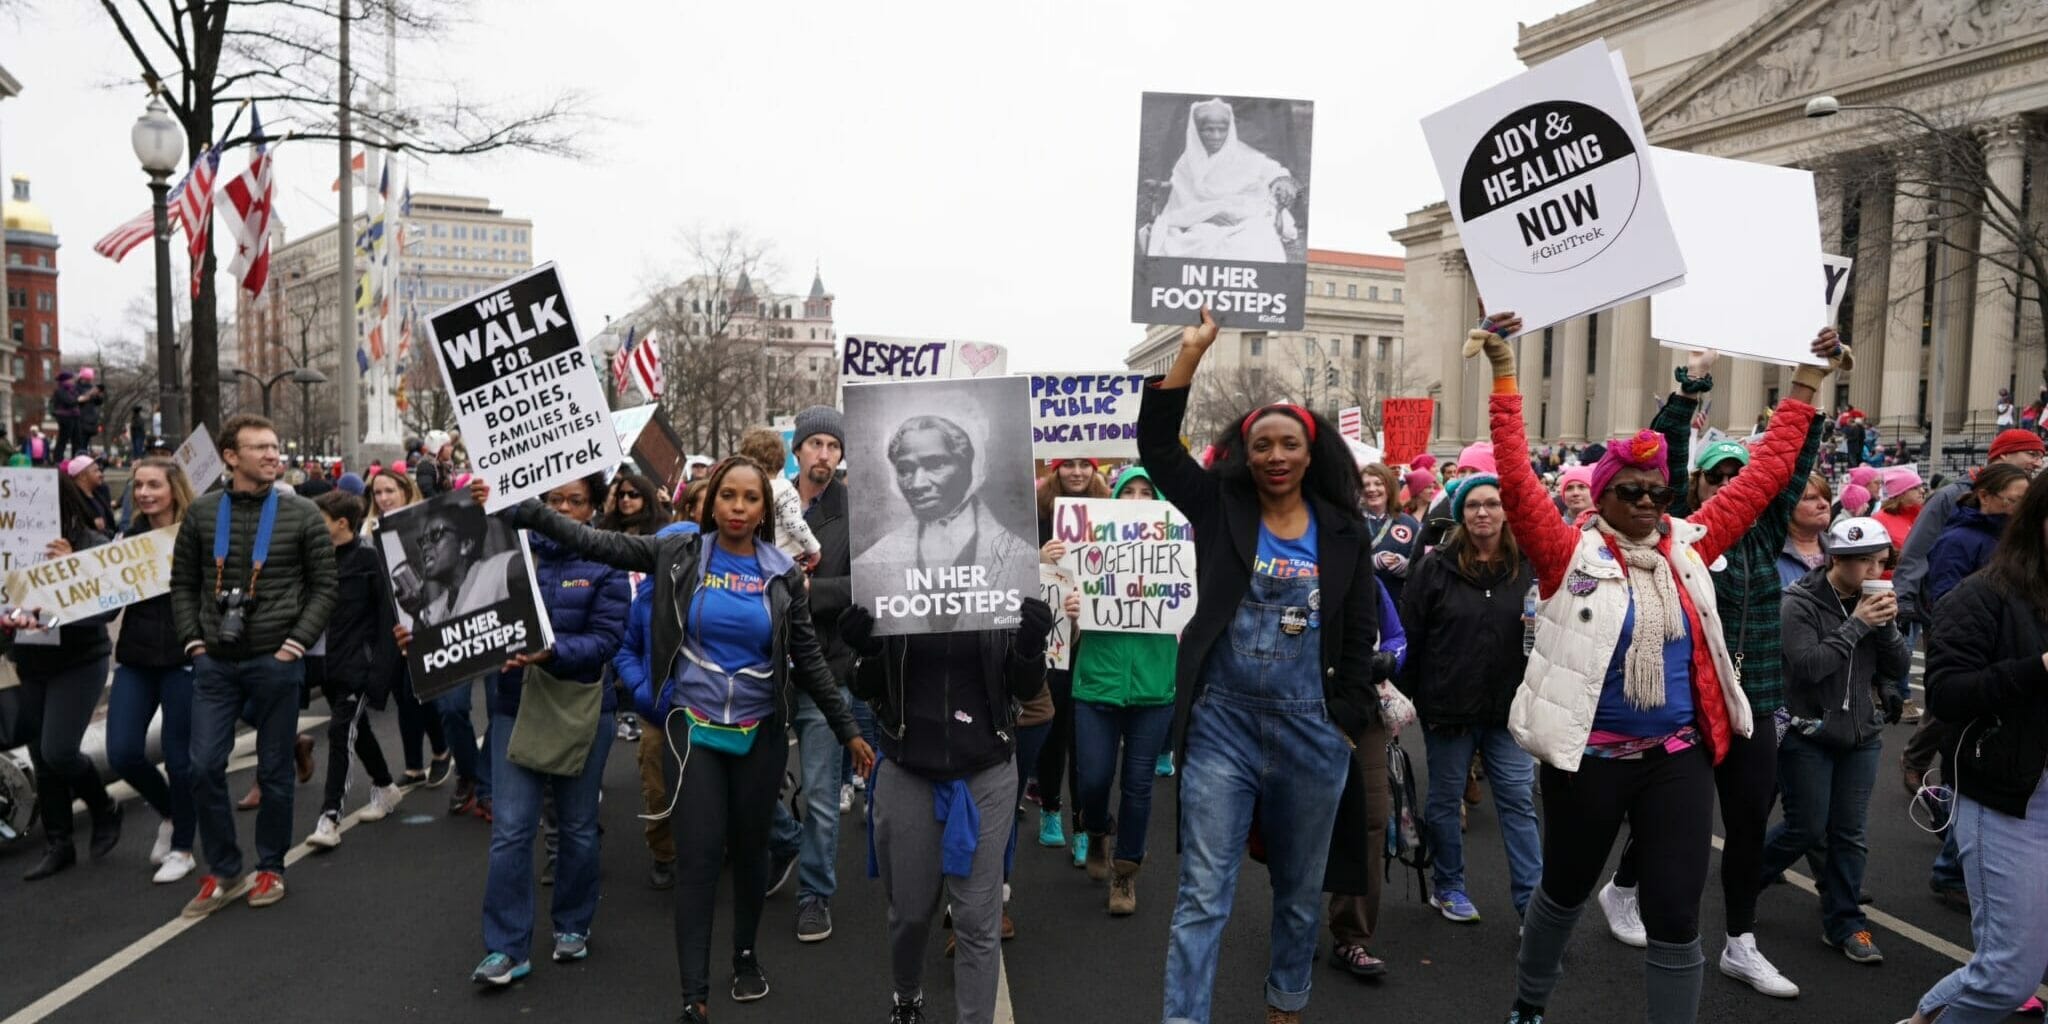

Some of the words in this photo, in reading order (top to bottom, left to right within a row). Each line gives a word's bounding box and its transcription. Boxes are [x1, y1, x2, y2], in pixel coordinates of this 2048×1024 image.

[1491, 118, 1539, 165] JOY
[1545, 112, 1573, 140] &
[1482, 134, 1603, 206] HEALING
[1516, 184, 1599, 247] NOW
[1530, 226, 1605, 265] #GirlTrek
[1182, 265, 1207, 286] IN
[1213, 266, 1259, 288] HER
[1824, 265, 1848, 305] Y
[475, 290, 514, 320] WE
[1151, 287, 1287, 314] FOOTSTEPS
[443, 294, 567, 370] WALK
[492, 347, 533, 377] FOR
[843, 337, 946, 377] RESPECT
[458, 351, 586, 416] HEALTHIER
[1031, 375, 1144, 397] PROTECT
[485, 385, 572, 429] BODIES,
[489, 408, 563, 448] FAMILIES
[569, 402, 581, 416] &
[1040, 395, 1116, 418] PUBLIC
[1386, 400, 1428, 413] MAKE
[478, 411, 602, 470] COMMUNITIES!
[1033, 423, 1138, 443] DUCATION
[1389, 430, 1426, 446] KIND
[498, 439, 603, 495] #GirlTrek
[1056, 503, 1117, 543] When
[1122, 522, 1150, 541] we
[27, 558, 81, 588] KEEP
[92, 537, 156, 569] YOUR
[905, 568, 933, 591] IN
[938, 565, 988, 588] HER
[1070, 541, 1189, 578] TOGETHER
[1289, 558, 1314, 568] TEAM
[875, 589, 1022, 619] FOOTSTEPS
[1083, 574, 1116, 597] will
[1126, 575, 1191, 610] always
[440, 623, 462, 647] IN
[463, 610, 501, 641] HER
[1092, 598, 1166, 629] WIN
[423, 620, 527, 674] FOOTSTEPS
